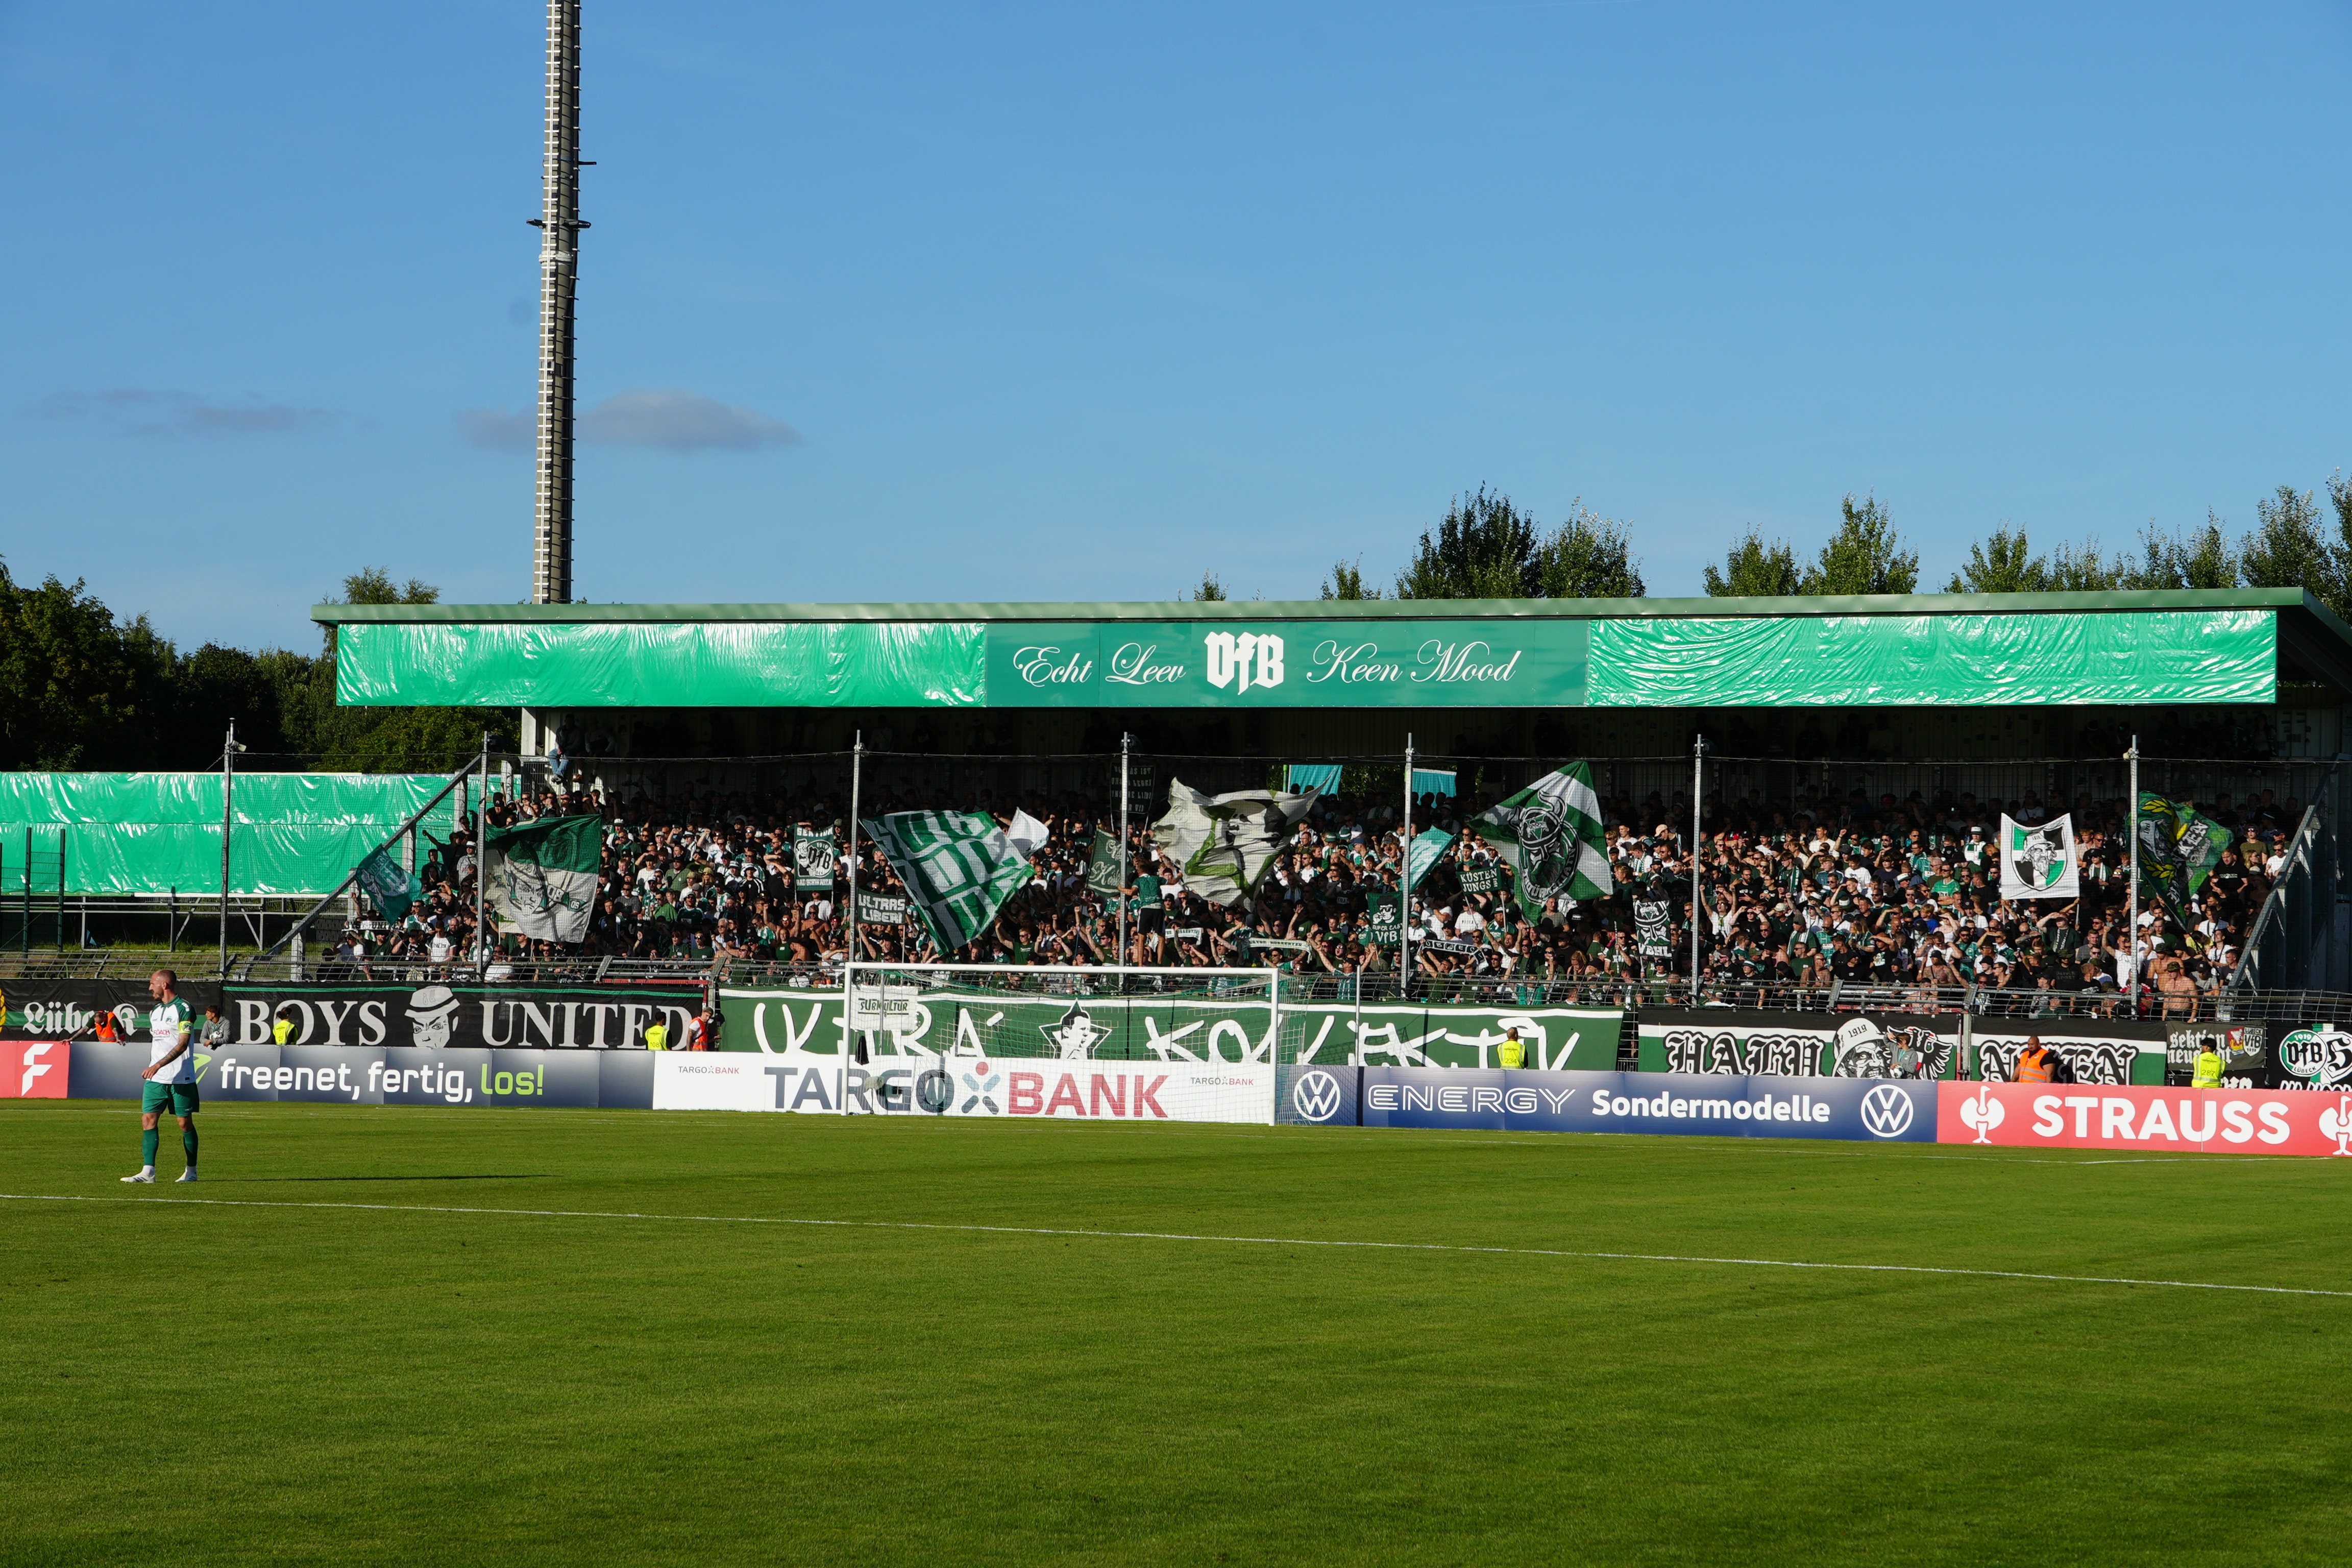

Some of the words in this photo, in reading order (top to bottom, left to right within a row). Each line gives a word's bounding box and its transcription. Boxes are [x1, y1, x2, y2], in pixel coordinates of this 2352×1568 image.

[1013, 646, 1093, 688] Echt
[1105, 642, 1187, 685] Leev
[1204, 631, 1284, 696] VfB
[1306, 640, 1403, 683] Keen
[1410, 639, 1522, 683] Mood
[1459, 868, 1497, 883] KÜSTEN
[1463, 880, 1491, 892] JUNGS
[858, 893, 905, 911] ULTRAS
[862, 908, 902, 923] LIBERI
[1638, 942, 1672, 957] VBHL
[235, 999, 386, 1046] BOYS
[479, 1000, 693, 1051] UNITED
[1848, 1024, 1868, 1038] 1919
[2244, 1035, 2261, 1048] VfB
[220, 1058, 360, 1100] freenet,
[368, 1061, 472, 1103] fertig,
[481, 1063, 544, 1095] los!
[1368, 1084, 1576, 1114] ENERGY
[1591, 1089, 1830, 1122] Sondermodelle
[2031, 1095, 2290, 1144] STRAUSS
